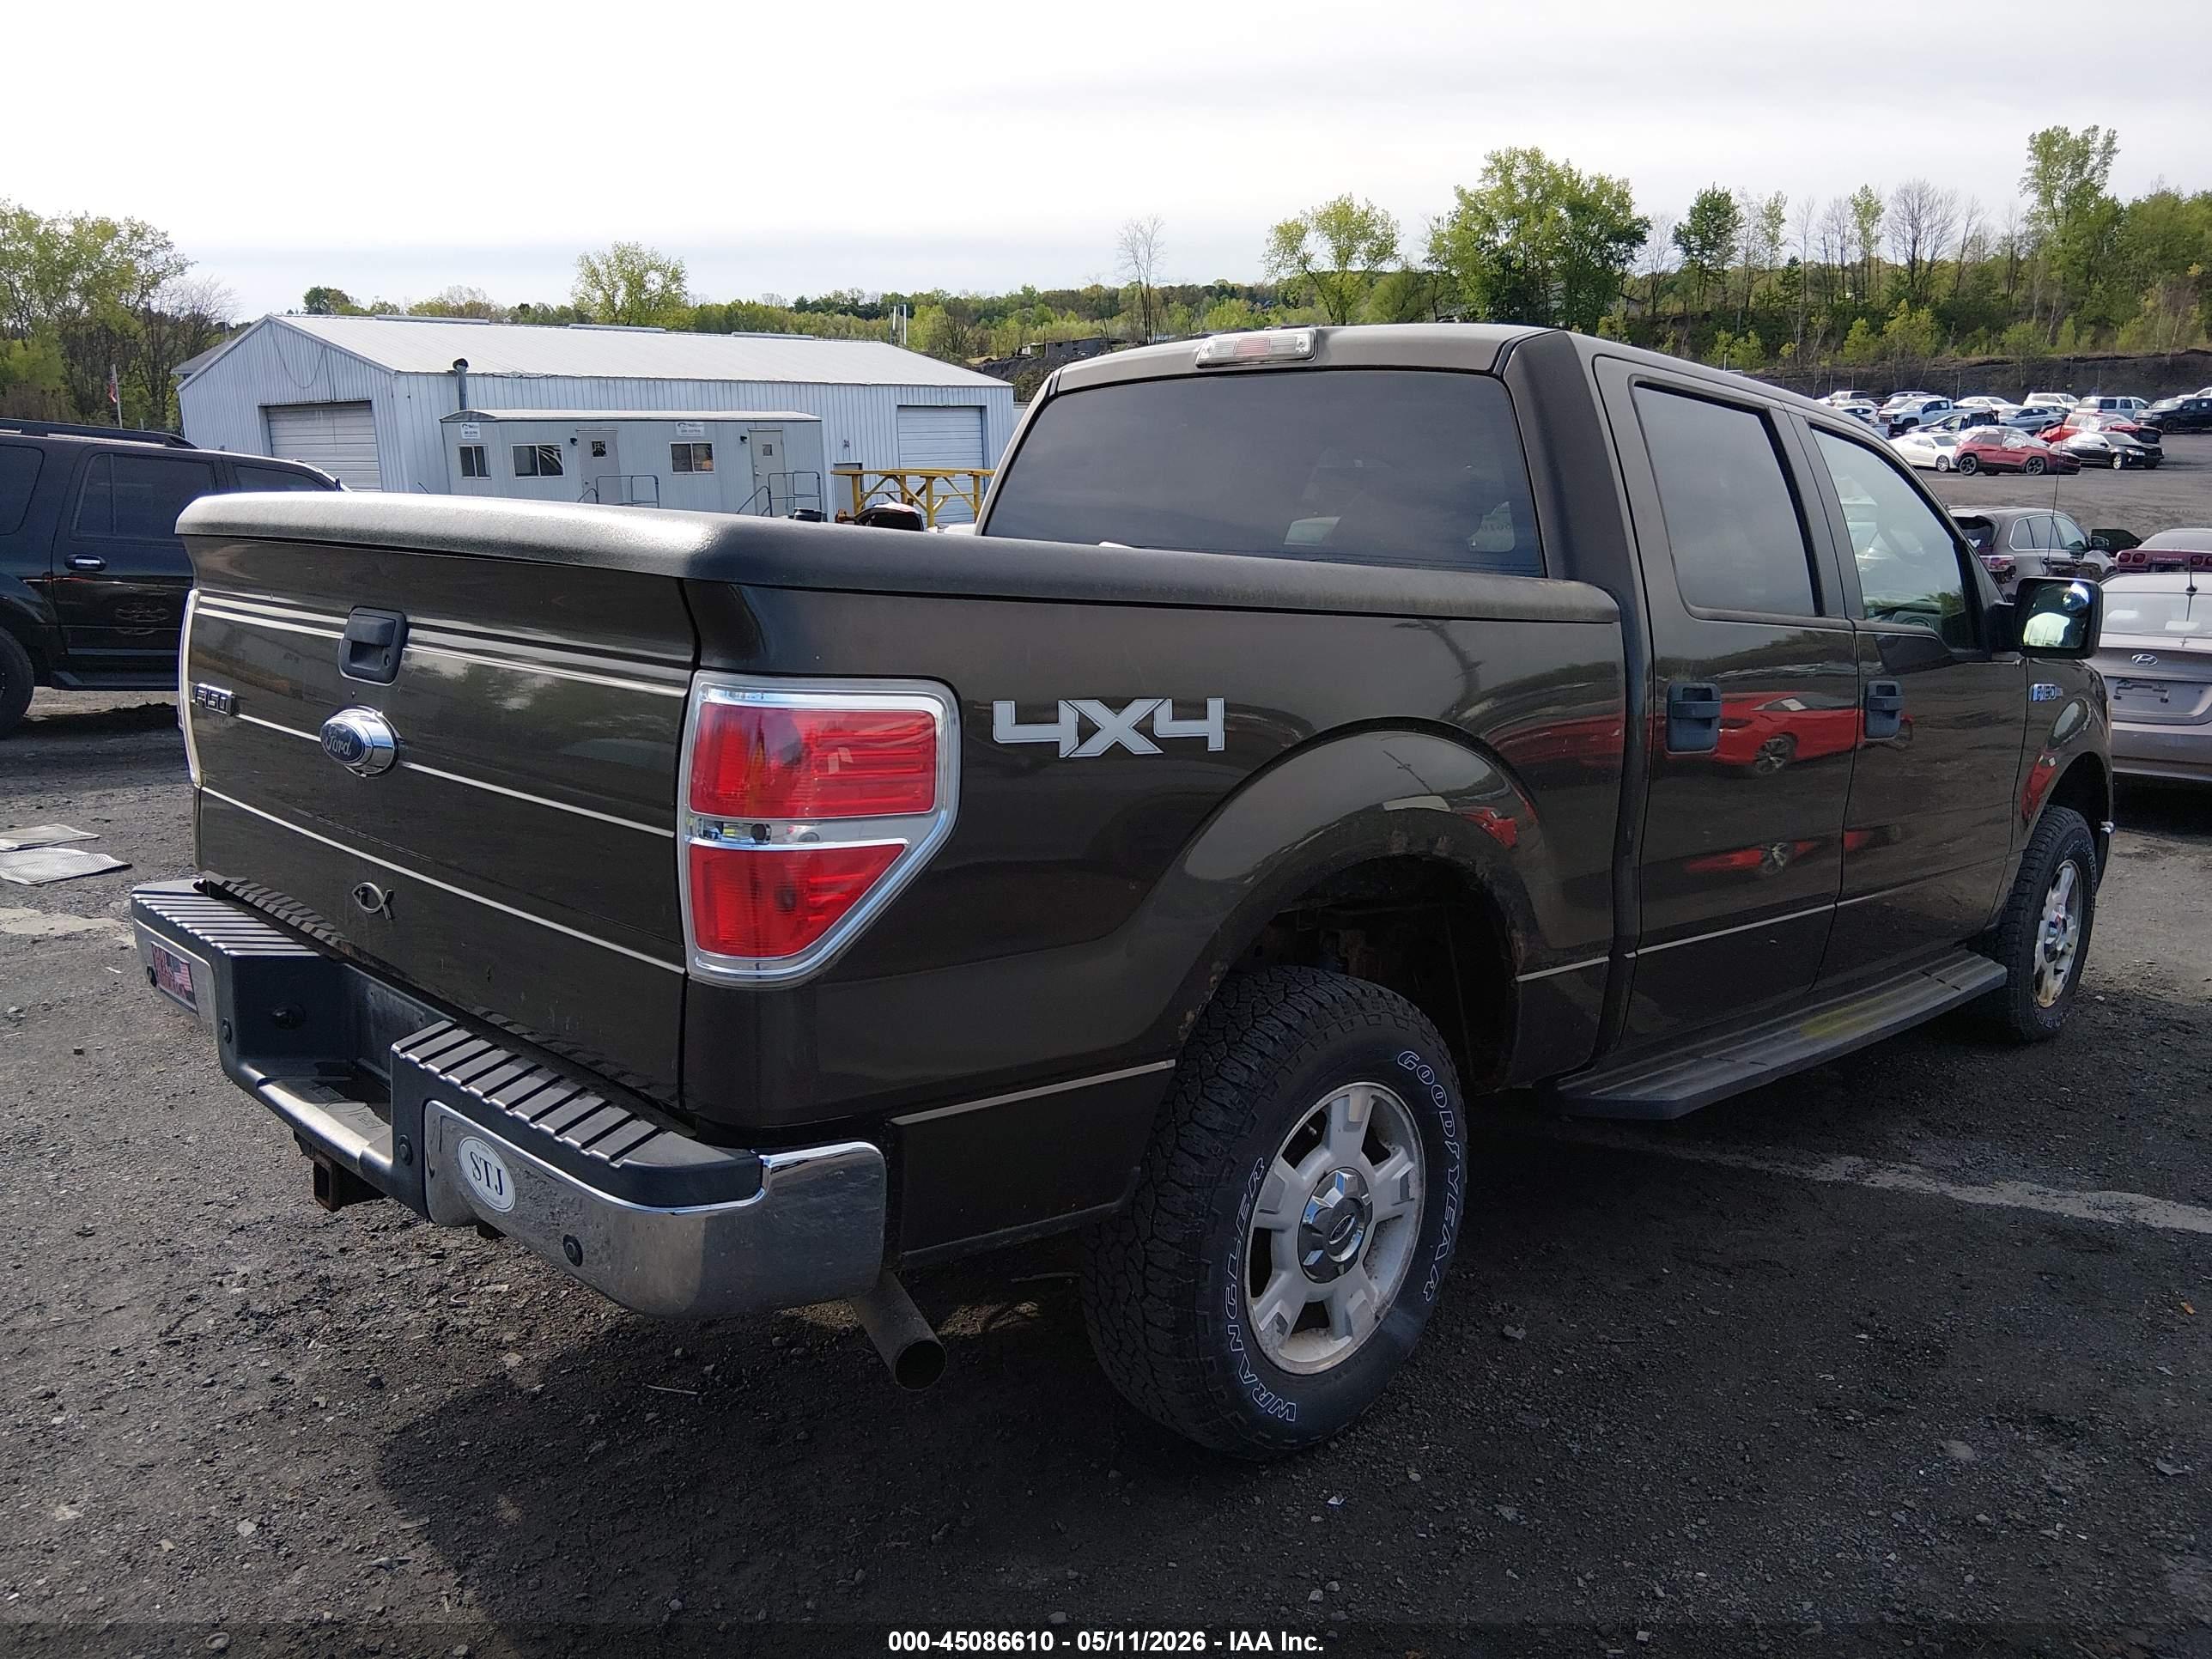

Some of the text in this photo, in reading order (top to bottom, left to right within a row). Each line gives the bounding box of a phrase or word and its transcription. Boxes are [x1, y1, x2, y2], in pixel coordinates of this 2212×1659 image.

[325, 724, 354, 757] Ford
[993, 698, 1225, 758] 4X4
[470, 1151, 503, 1196] STJ
[1397, 1050, 1460, 1302] GOODYEAR
[1225, 1158, 1297, 1421] WRANGLER
